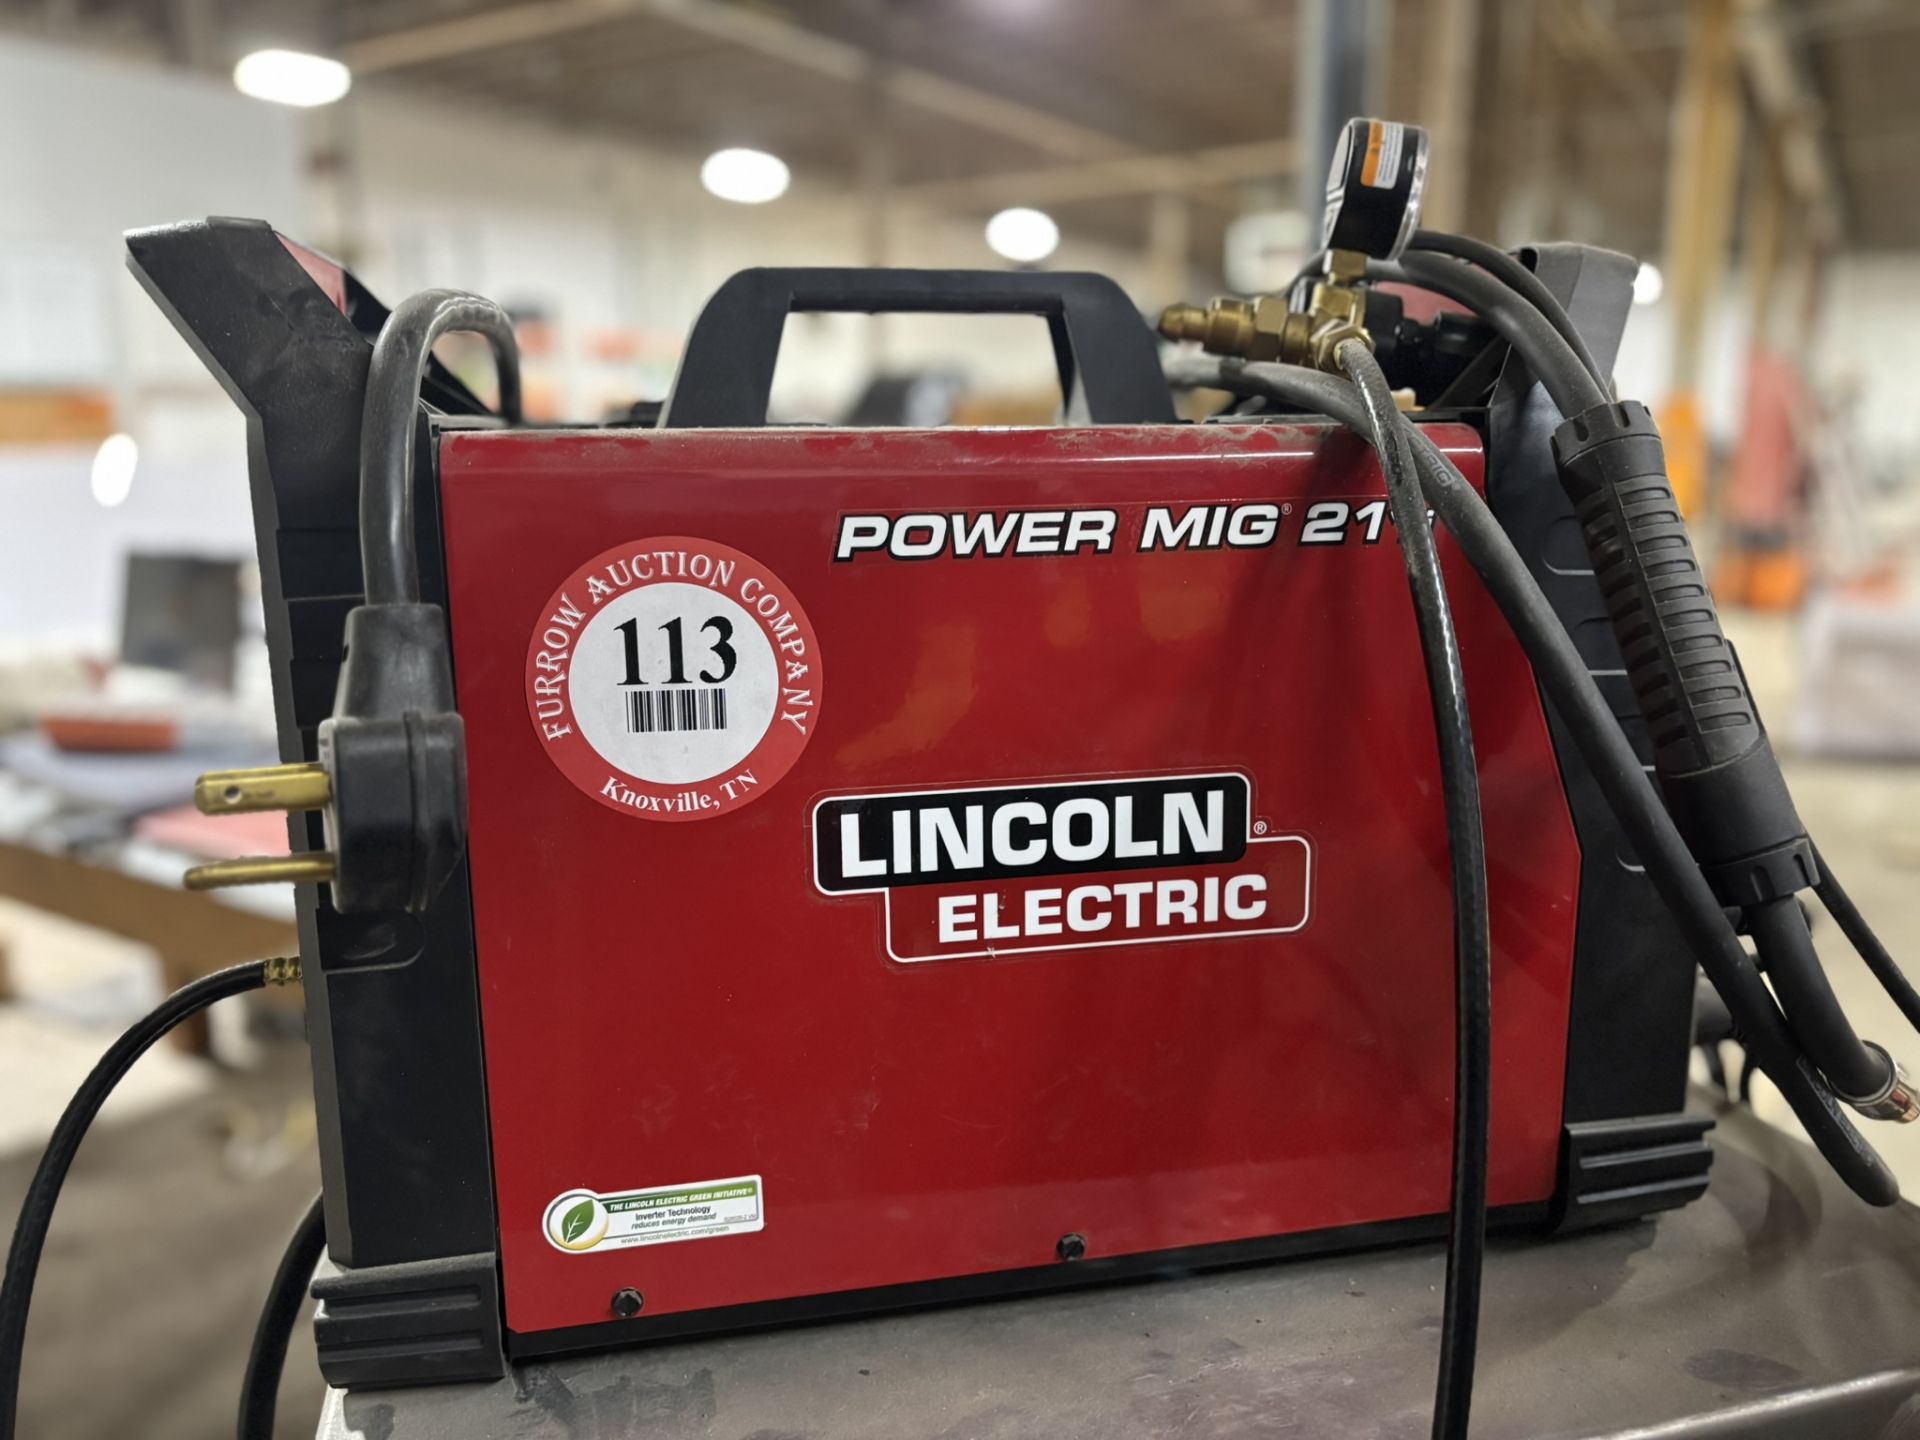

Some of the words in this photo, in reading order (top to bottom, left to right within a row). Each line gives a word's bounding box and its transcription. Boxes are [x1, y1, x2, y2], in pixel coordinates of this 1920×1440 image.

[834, 509, 1118, 562] POWER
[534, 593, 587, 742] FURROW
[587, 550, 737, 605] AUCTION
[740, 577, 813, 735] COMPANY
[613, 616, 737, 685] 113
[600, 776, 720, 812] Knoxville,
[720, 769, 758, 800] TN
[840, 789, 1225, 878] LINCOLN
[938, 874, 1268, 943] ELECTRIC
[610, 1203, 624, 1211] THE
[624, 1199, 655, 1209] LINCOLN
[655, 1195, 688, 1206] ELECTRIC
[689, 1193, 712, 1202] GREEN
[631, 1221, 660, 1230] reduces
[661, 1216, 686, 1228] energy
[687, 1213, 717, 1222] demand
[635, 1211, 666, 1221] Inverter
[667, 1205, 711, 1217] Technology
